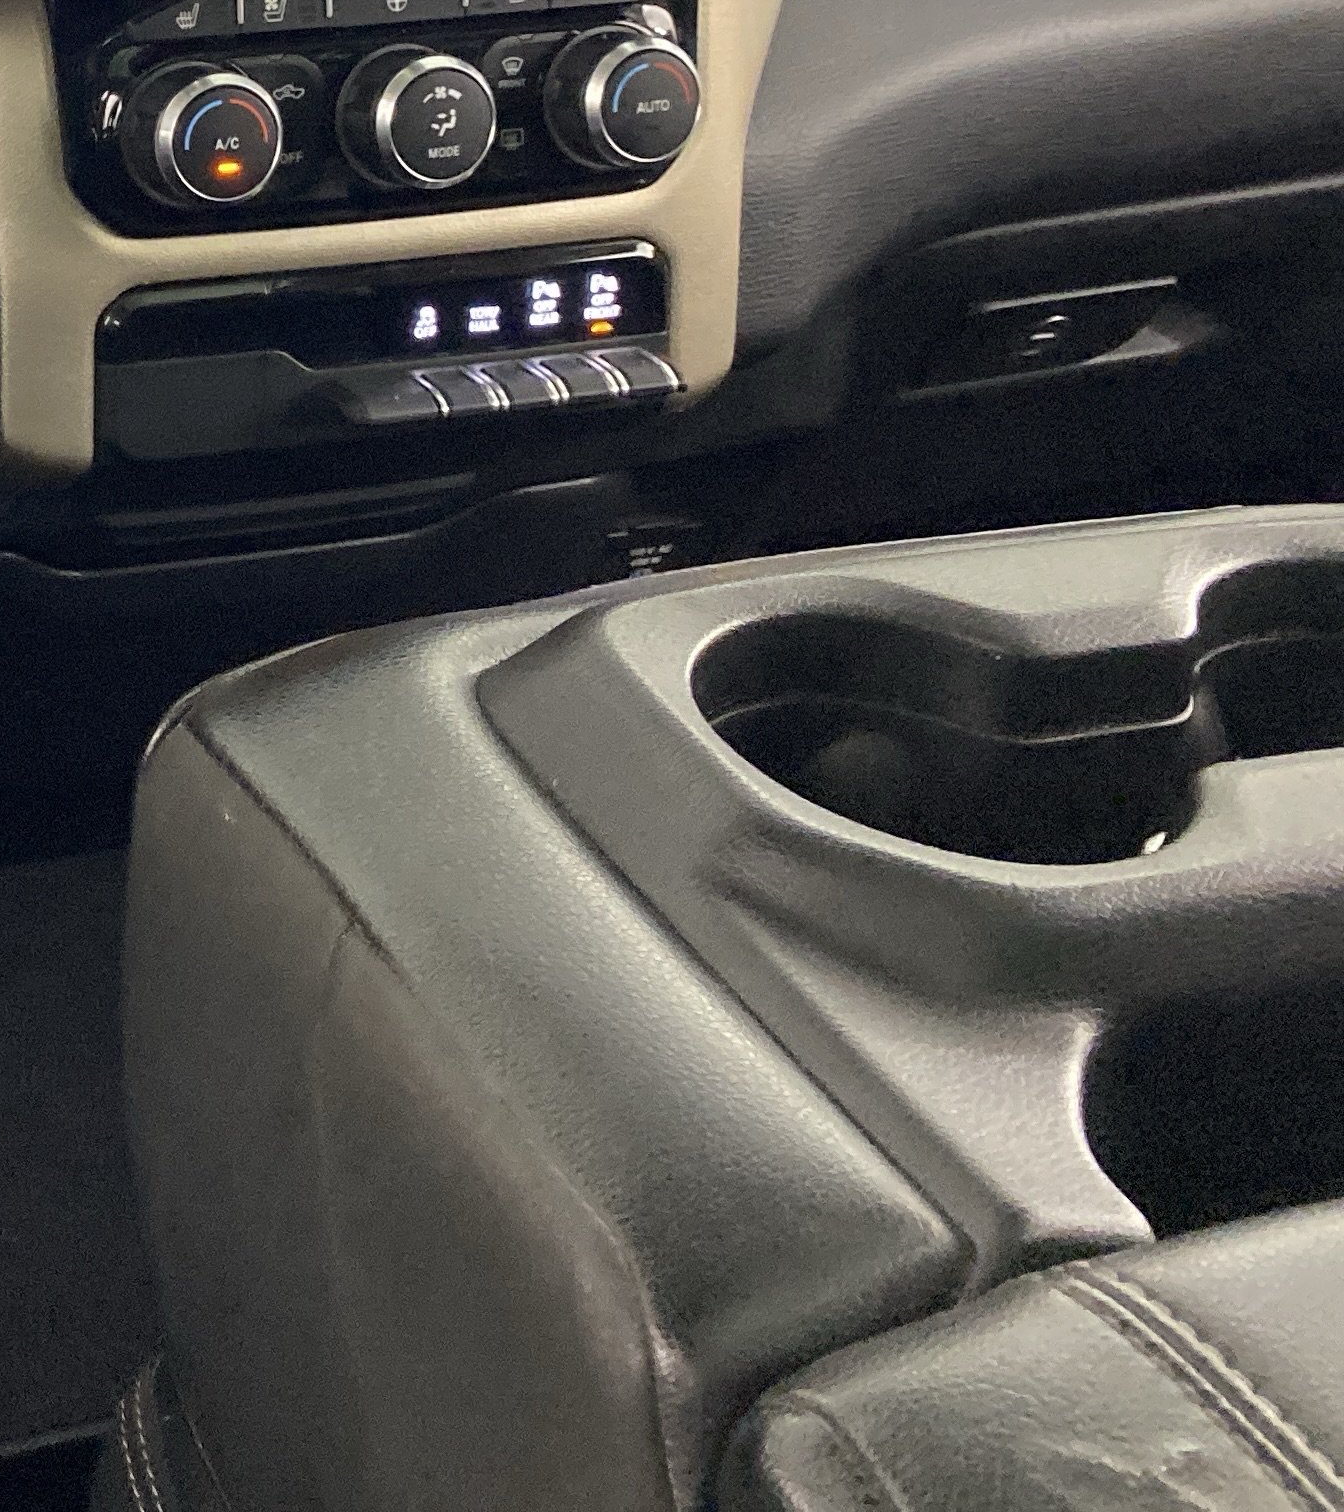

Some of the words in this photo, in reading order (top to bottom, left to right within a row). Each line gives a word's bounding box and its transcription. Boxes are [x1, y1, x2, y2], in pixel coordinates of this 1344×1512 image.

[636, 99, 670, 115] AUTO
[215, 137, 240, 152] A/C
[428, 145, 460, 160] MODE
